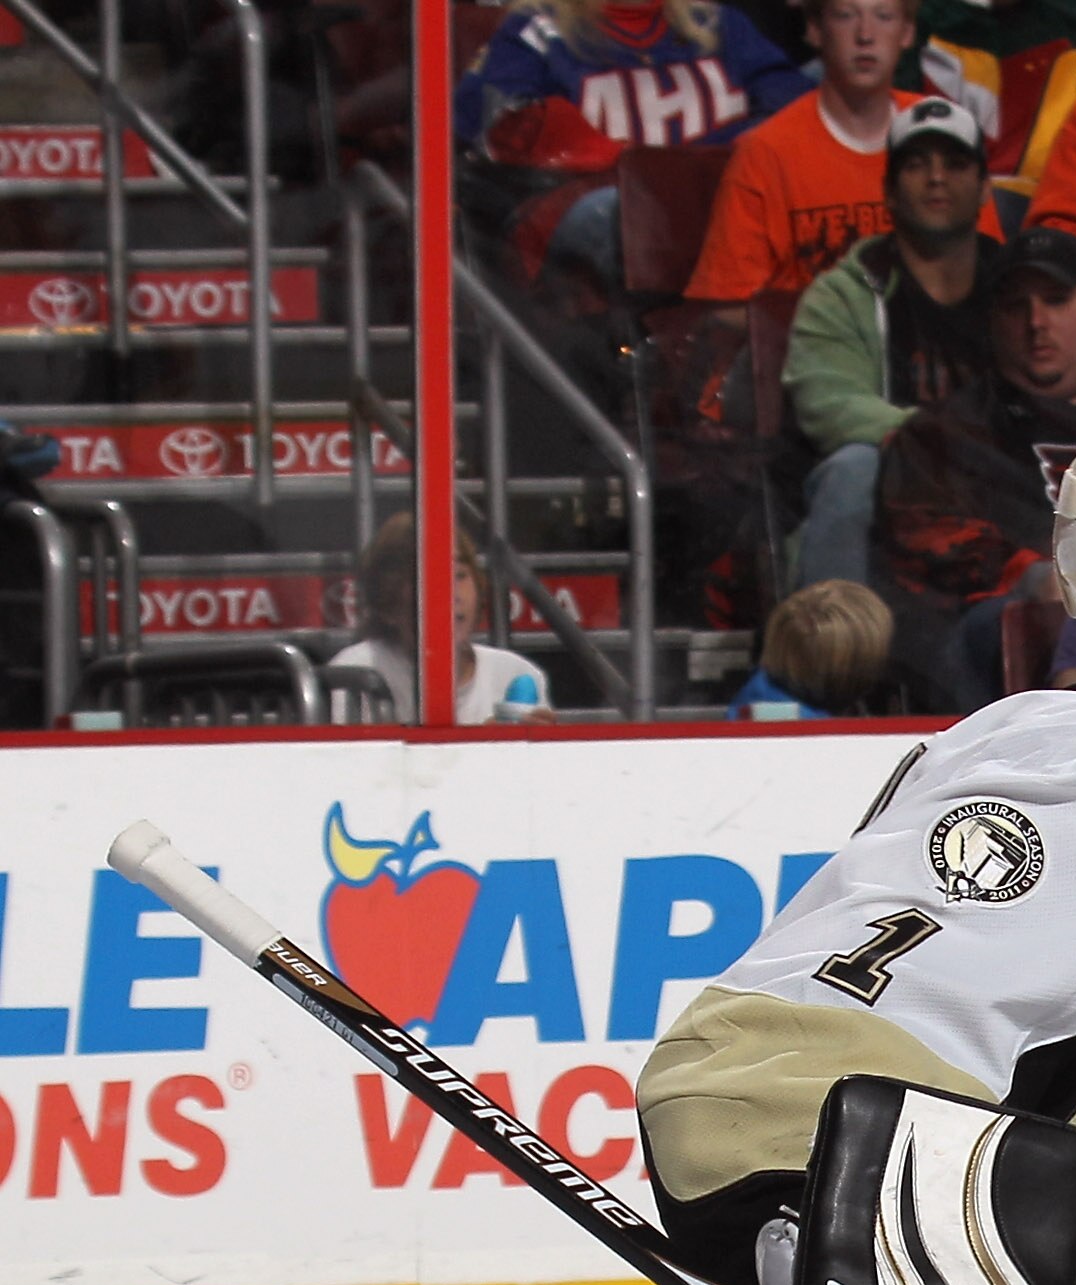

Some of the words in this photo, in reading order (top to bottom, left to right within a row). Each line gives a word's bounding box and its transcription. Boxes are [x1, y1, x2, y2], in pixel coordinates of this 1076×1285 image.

[101, 281, 282, 318] OYOT
[107, 588, 280, 627] OYOTA
[942, 803, 1024, 828] INAUGURAL
[931, 835, 946, 869] 2010
[1022, 827, 1043, 882] SEASON
[988, 884, 1021, 900] 2011
[425, 853, 838, 1047] AP
[810, 907, 944, 1008] 1
[0, 1073, 228, 1200] NS
[353, 1063, 652, 1190] VAC
[361, 1023, 644, 1230] SUPREME
